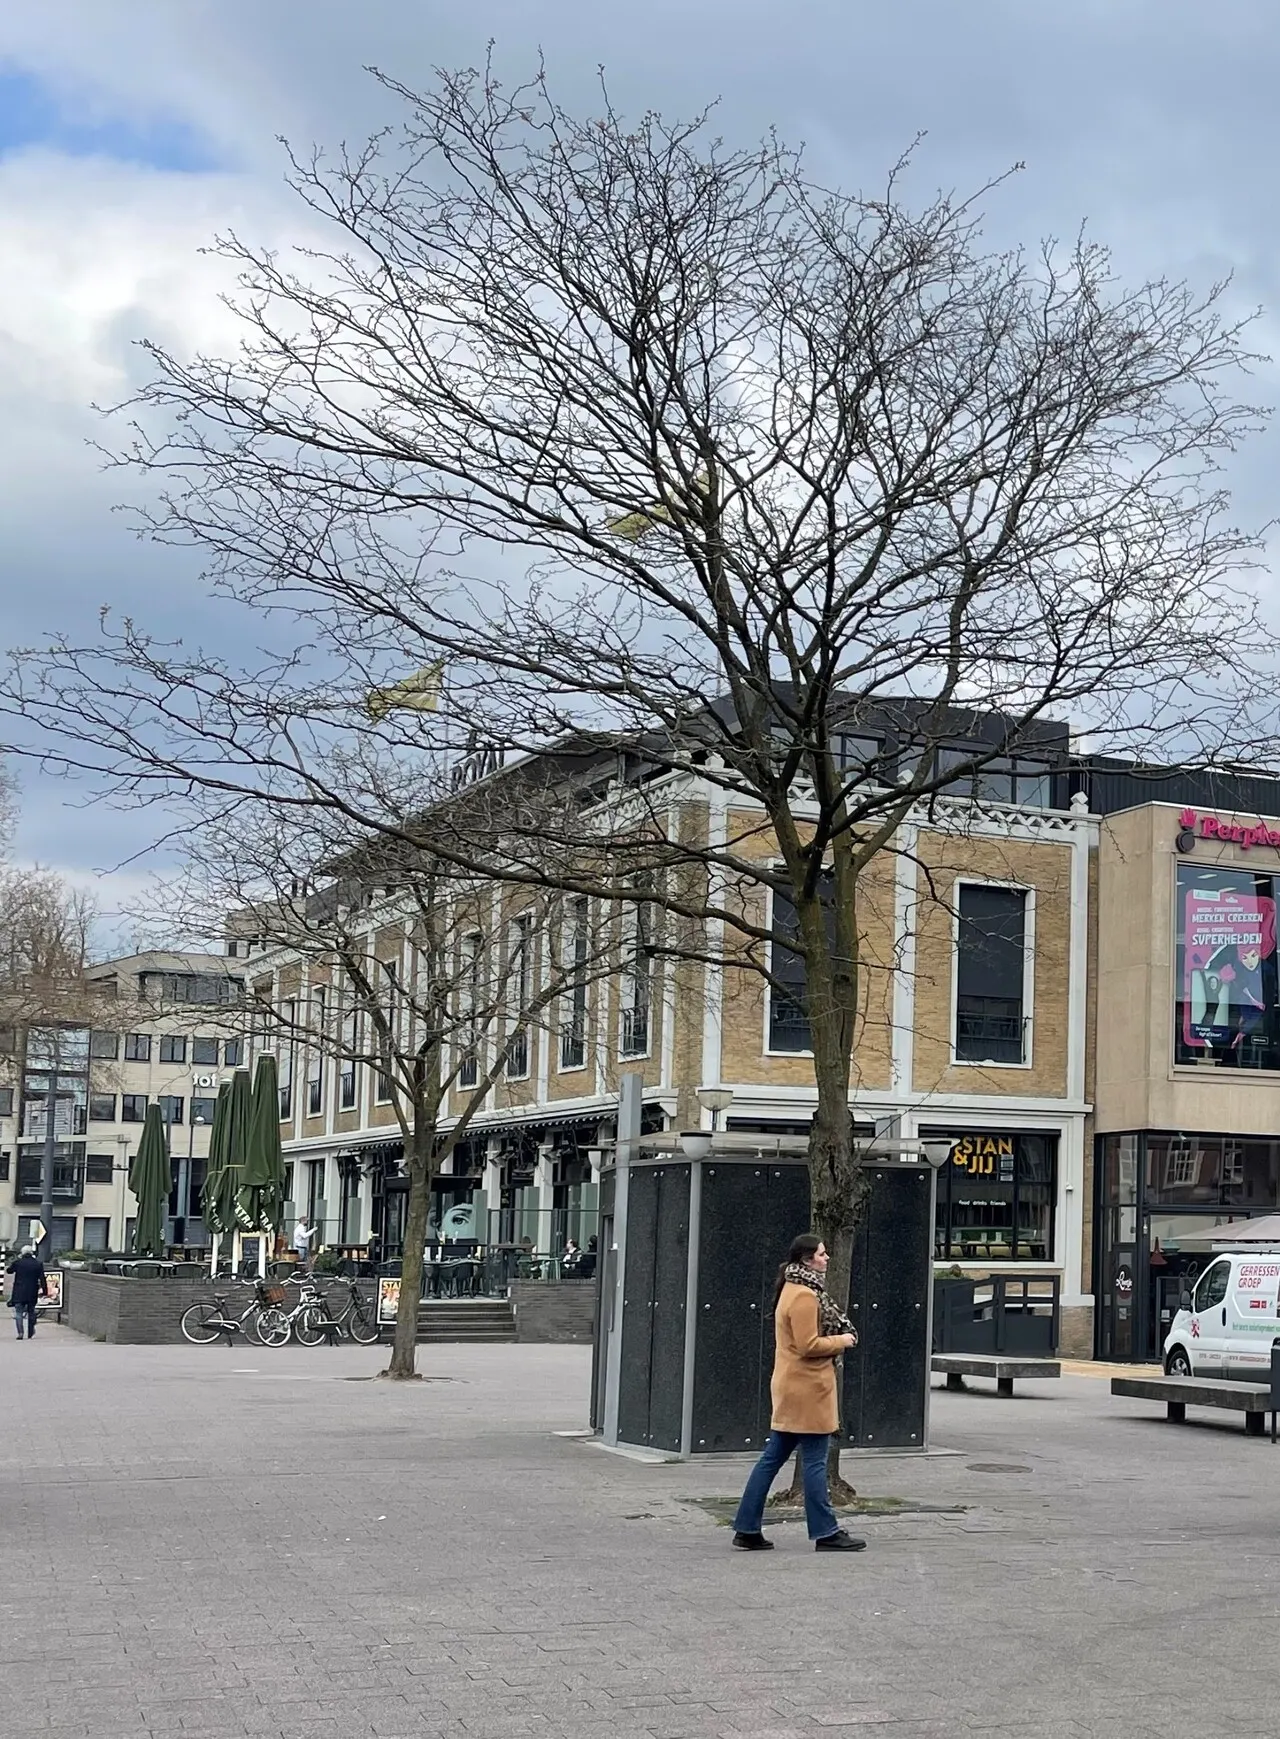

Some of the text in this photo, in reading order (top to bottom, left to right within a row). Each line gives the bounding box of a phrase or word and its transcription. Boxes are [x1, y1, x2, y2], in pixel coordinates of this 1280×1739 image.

[1192, 933, 1262, 946] SUPERHELDEN
[962, 1136, 1013, 1155] STAN
[953, 1145, 968, 1166] &
[968, 1155, 994, 1174] JIJ
[1240, 1265, 1280, 1277] GERRESSEN
[1238, 1278, 1262, 1288] GROEP
